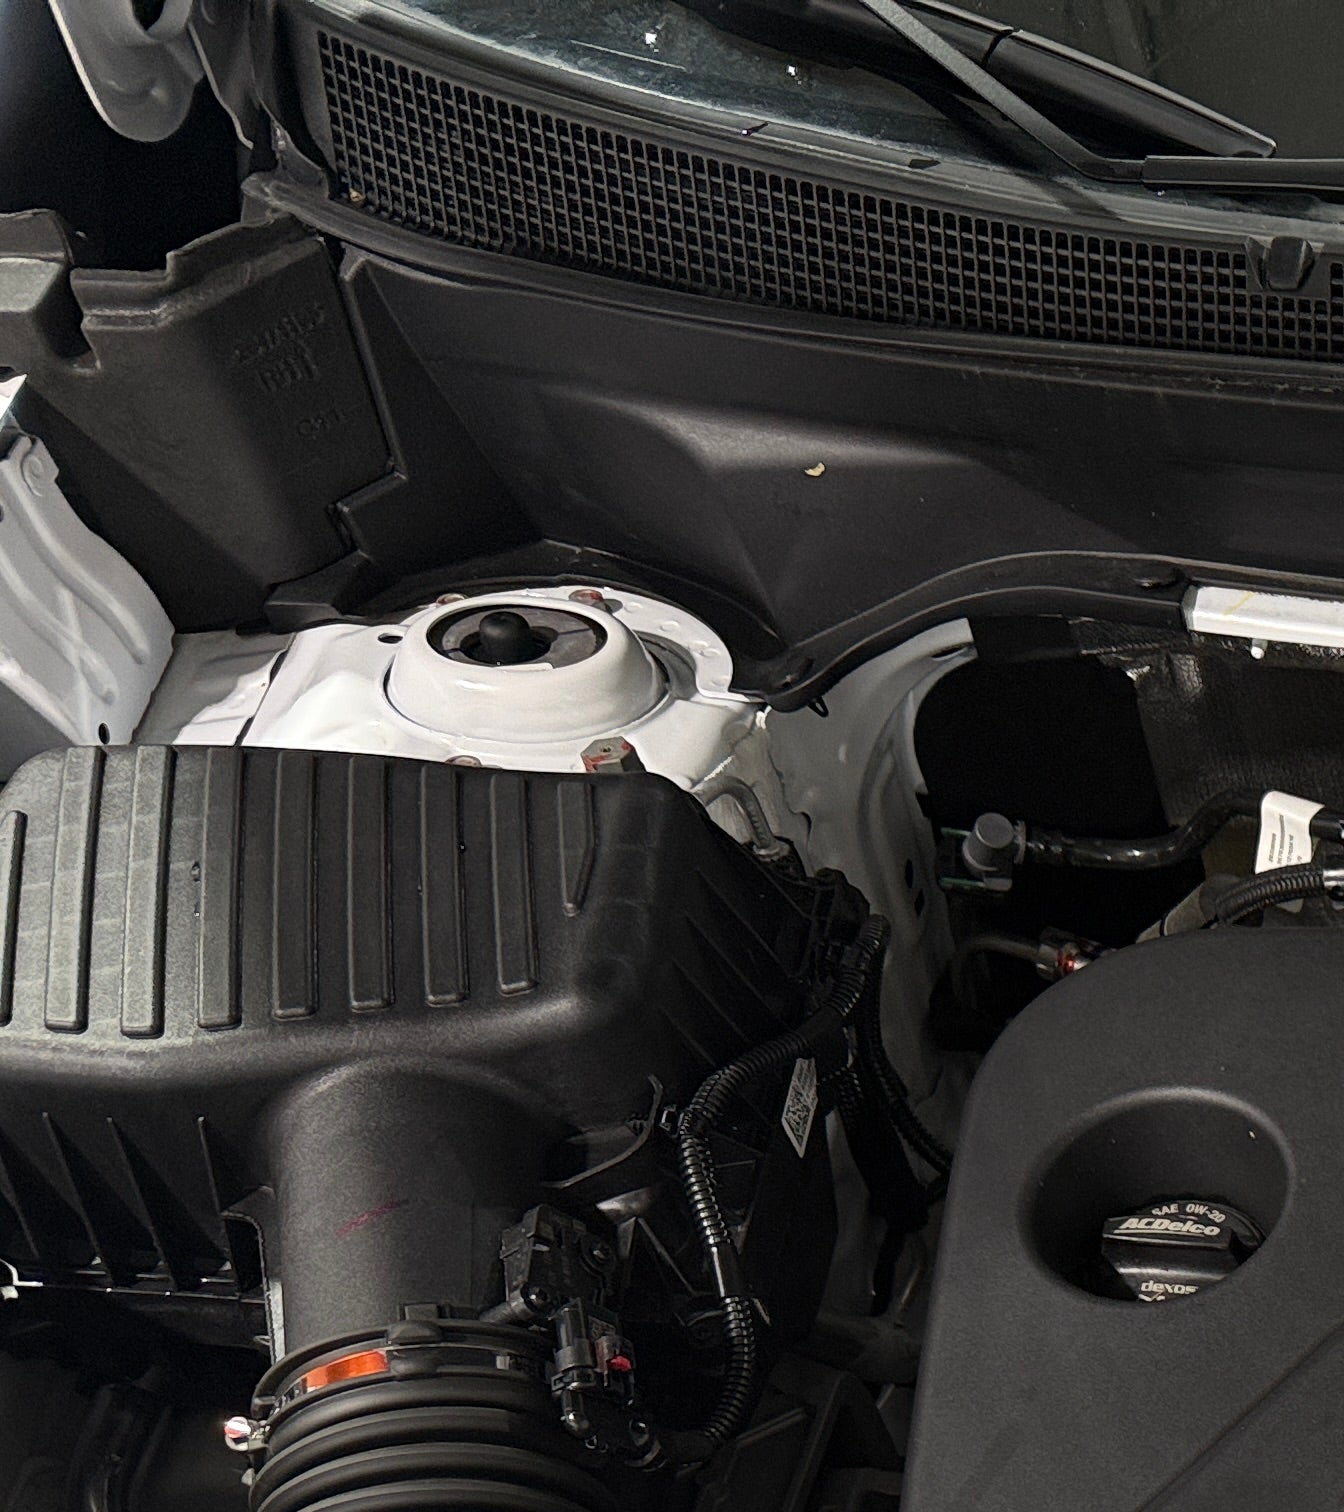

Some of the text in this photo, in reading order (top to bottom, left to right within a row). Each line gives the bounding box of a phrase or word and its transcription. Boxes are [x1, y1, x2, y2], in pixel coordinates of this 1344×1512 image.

[1151, 1203, 1226, 1223] SAE 0W-20
[1119, 1217, 1221, 1236] ACDelco
